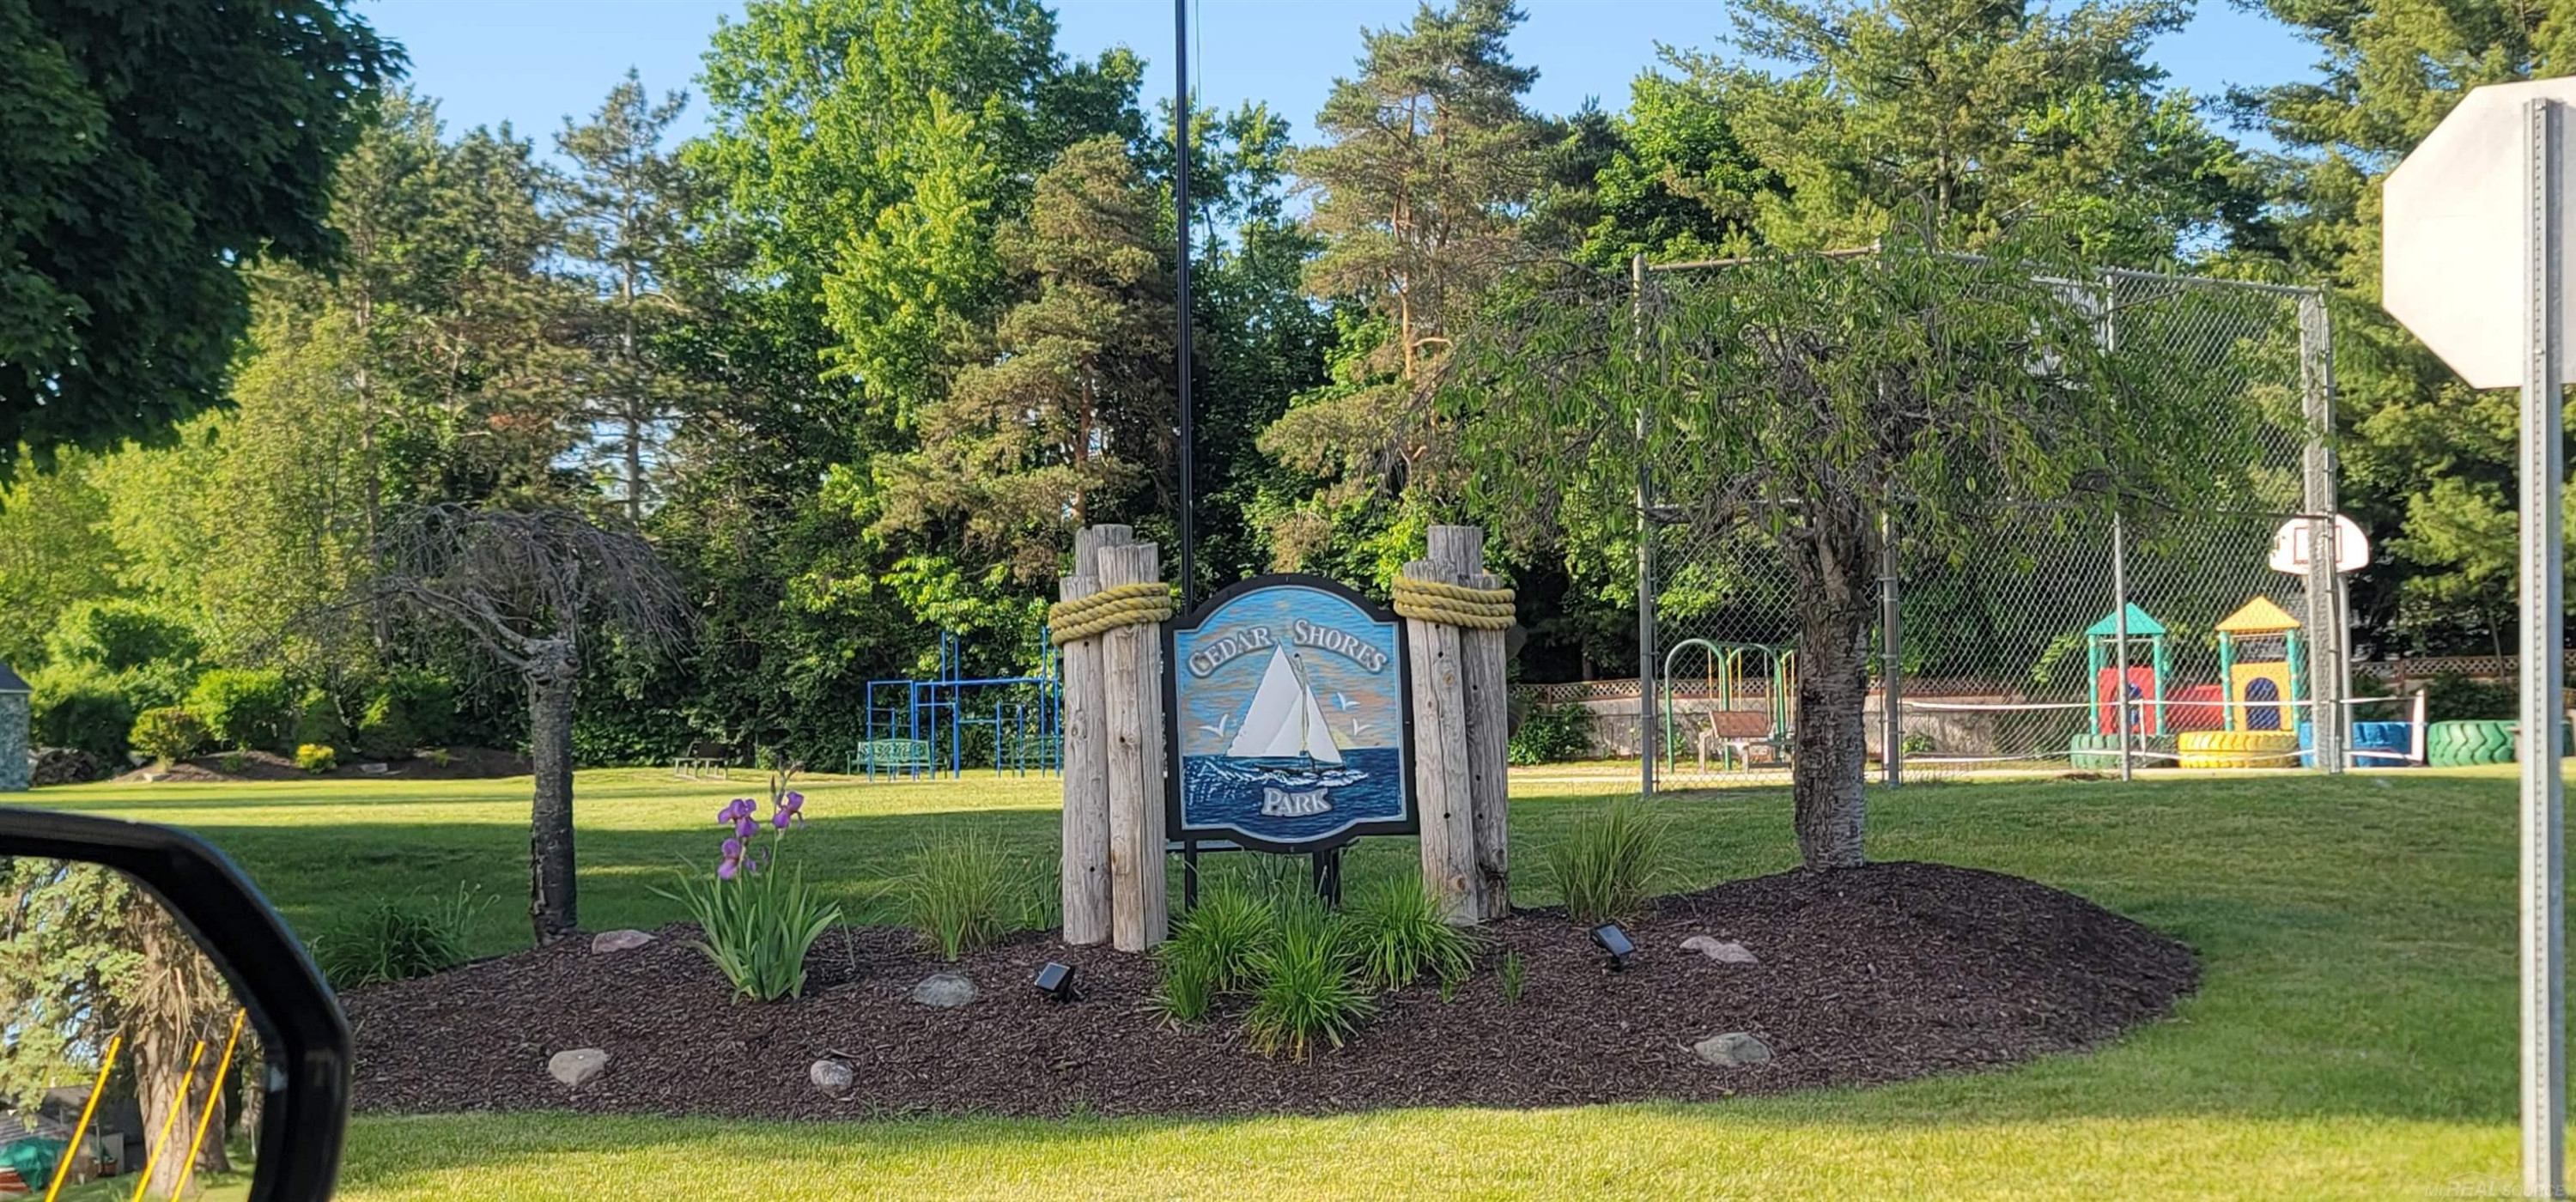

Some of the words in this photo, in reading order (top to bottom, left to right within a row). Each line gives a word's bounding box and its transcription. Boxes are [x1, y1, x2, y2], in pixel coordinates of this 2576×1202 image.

[1188, 627, 1273, 677] CEDAR
[1293, 618, 1388, 672] SHORES
[1265, 790, 1330, 814] PARK
